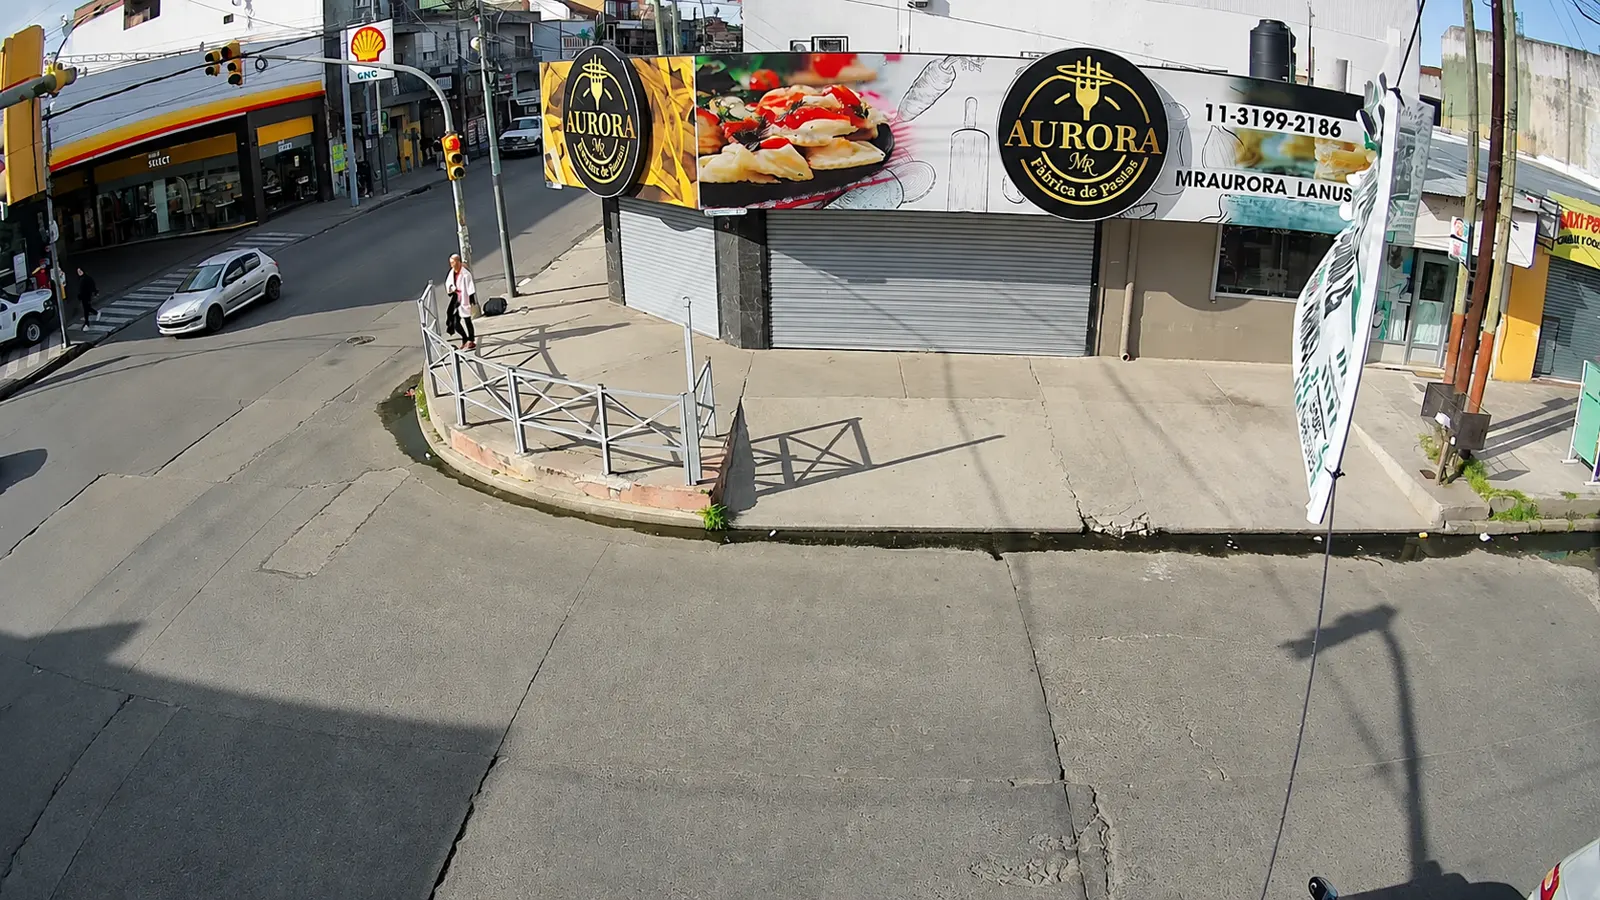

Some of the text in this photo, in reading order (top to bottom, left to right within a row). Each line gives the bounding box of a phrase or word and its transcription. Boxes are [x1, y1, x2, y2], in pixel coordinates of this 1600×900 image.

[357, 70, 378, 80] GNC
[566, 110, 636, 139] AURORA
[1205, 103, 1342, 138] 11-3199-2186
[1004, 119, 1162, 155] AURORA
[1068, 152, 1098, 177] MR
[1080, 184, 1098, 198] de
